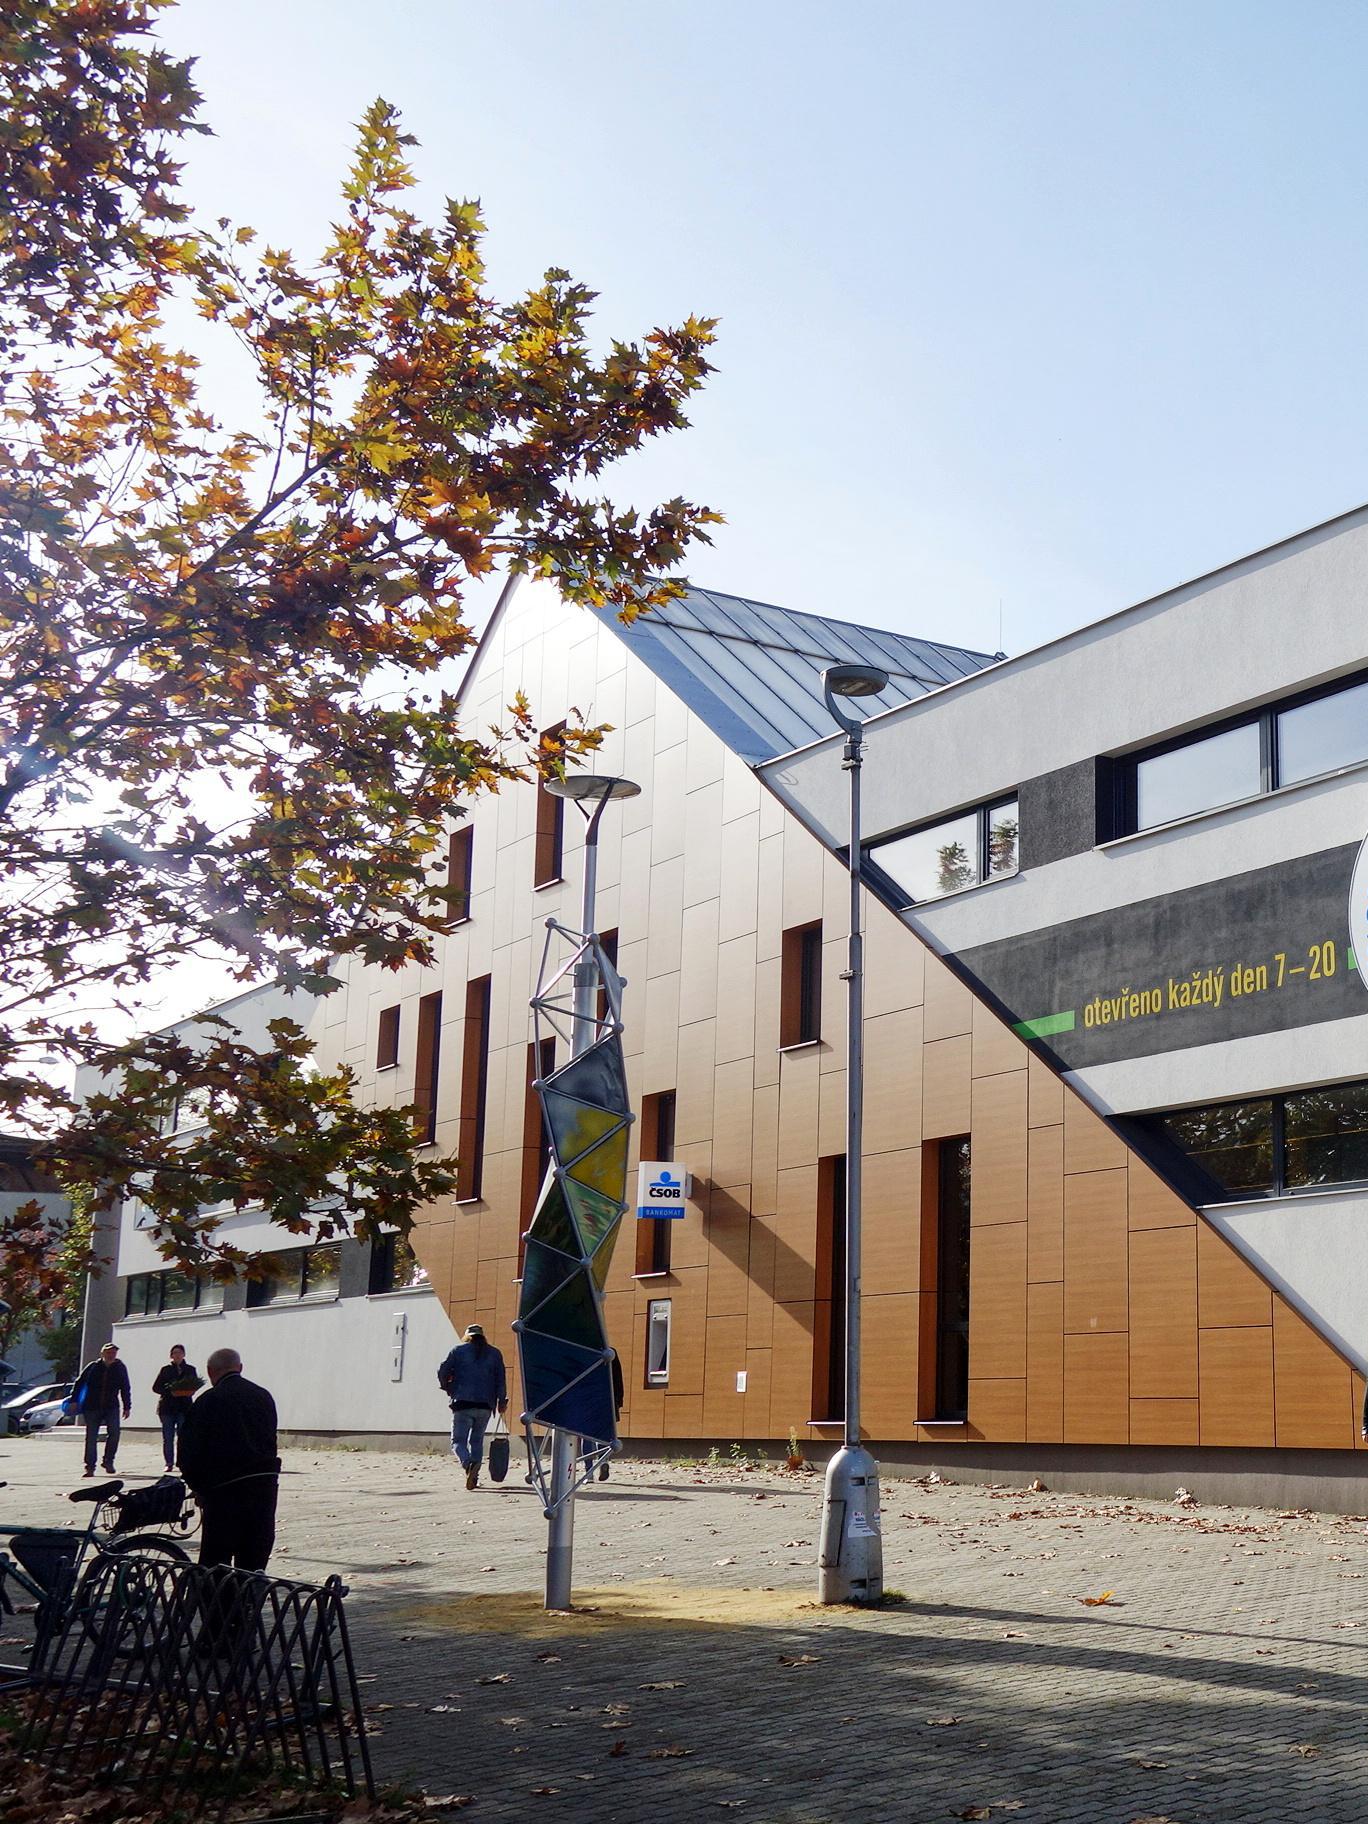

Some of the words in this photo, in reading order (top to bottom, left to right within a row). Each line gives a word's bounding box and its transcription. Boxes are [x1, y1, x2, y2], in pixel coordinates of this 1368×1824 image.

[1084, 987, 1162, 1028] otevřeno
[1168, 967, 1224, 1008] každý
[1230, 963, 1267, 997] den
[649, 1187, 681, 1198] ČSOB
